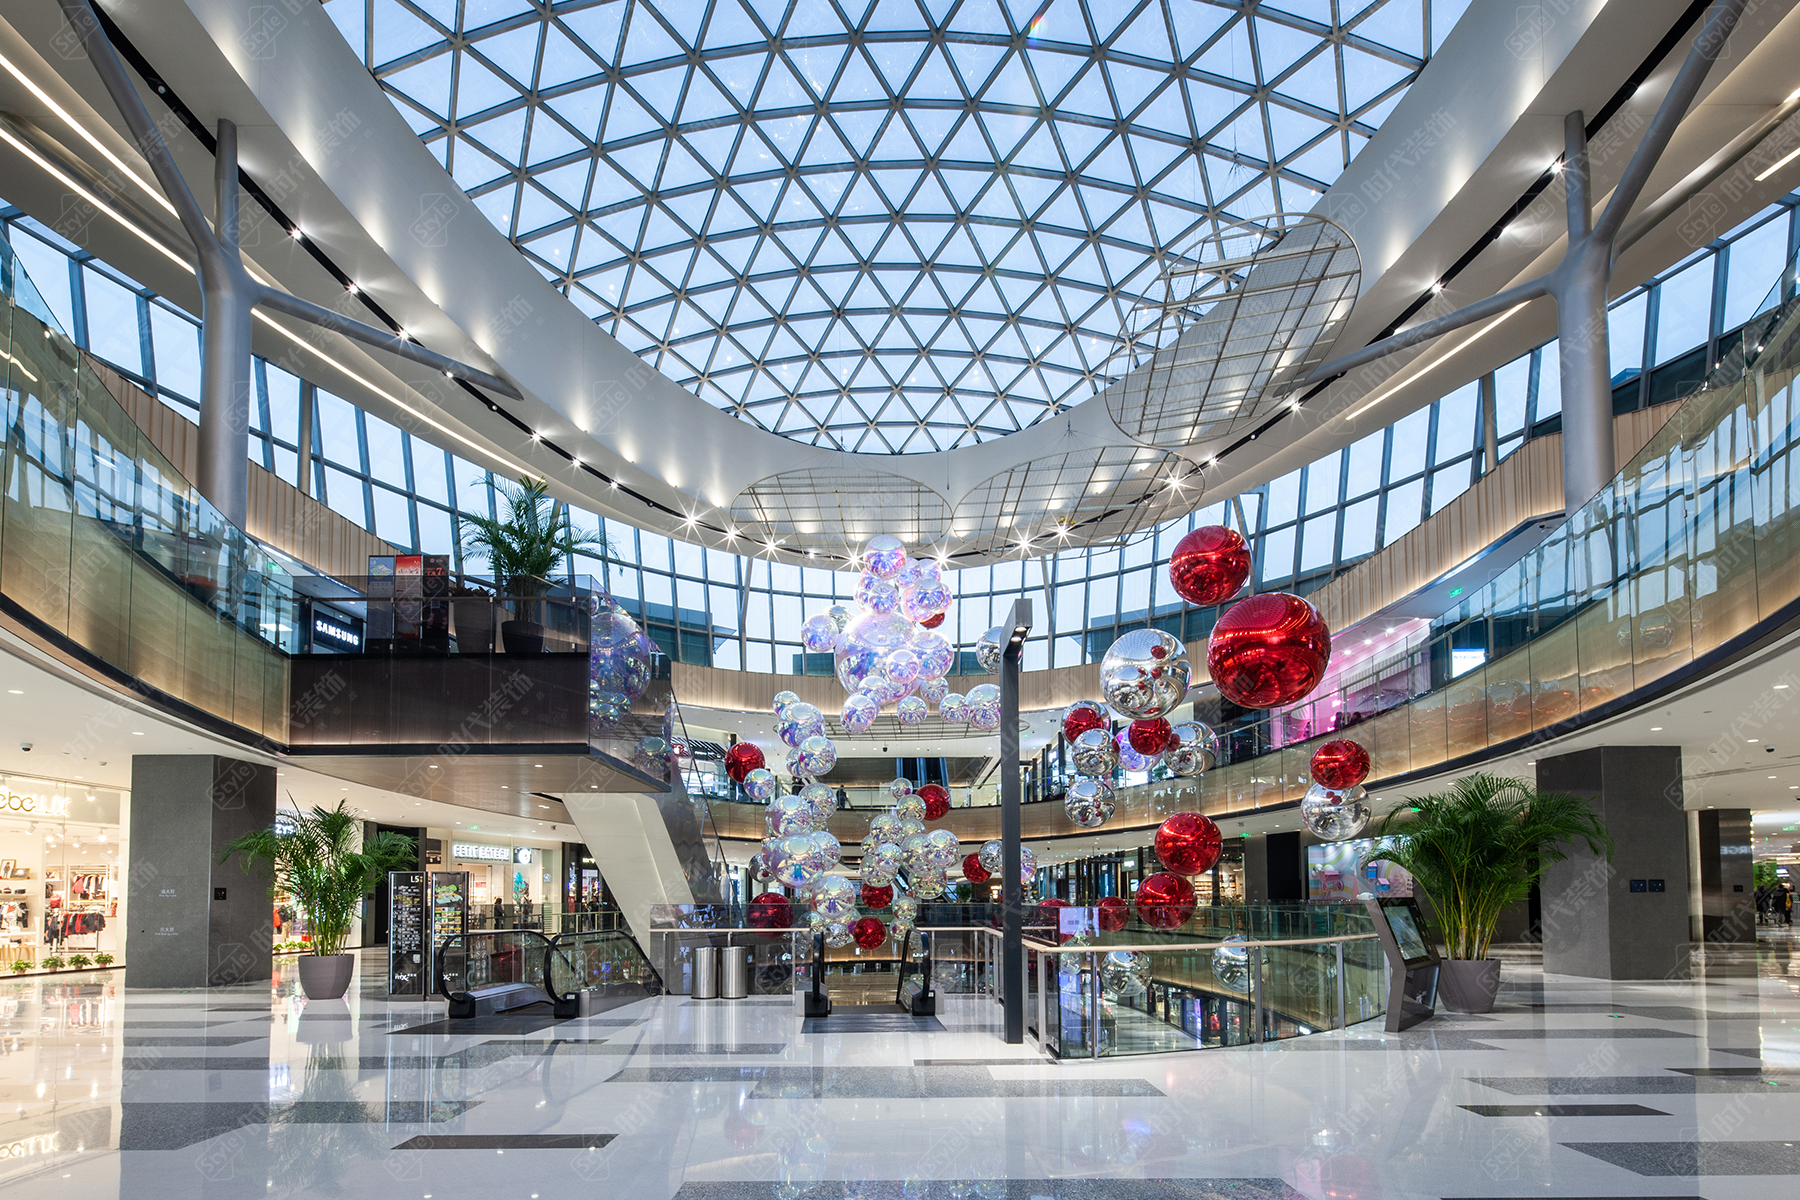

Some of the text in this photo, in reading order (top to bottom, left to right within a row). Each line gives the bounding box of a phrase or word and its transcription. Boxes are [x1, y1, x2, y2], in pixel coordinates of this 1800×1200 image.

[316, 620, 359, 646] SAMSUNG
[453, 844, 478, 857] PETIT
[410, 875, 420, 883] L5
